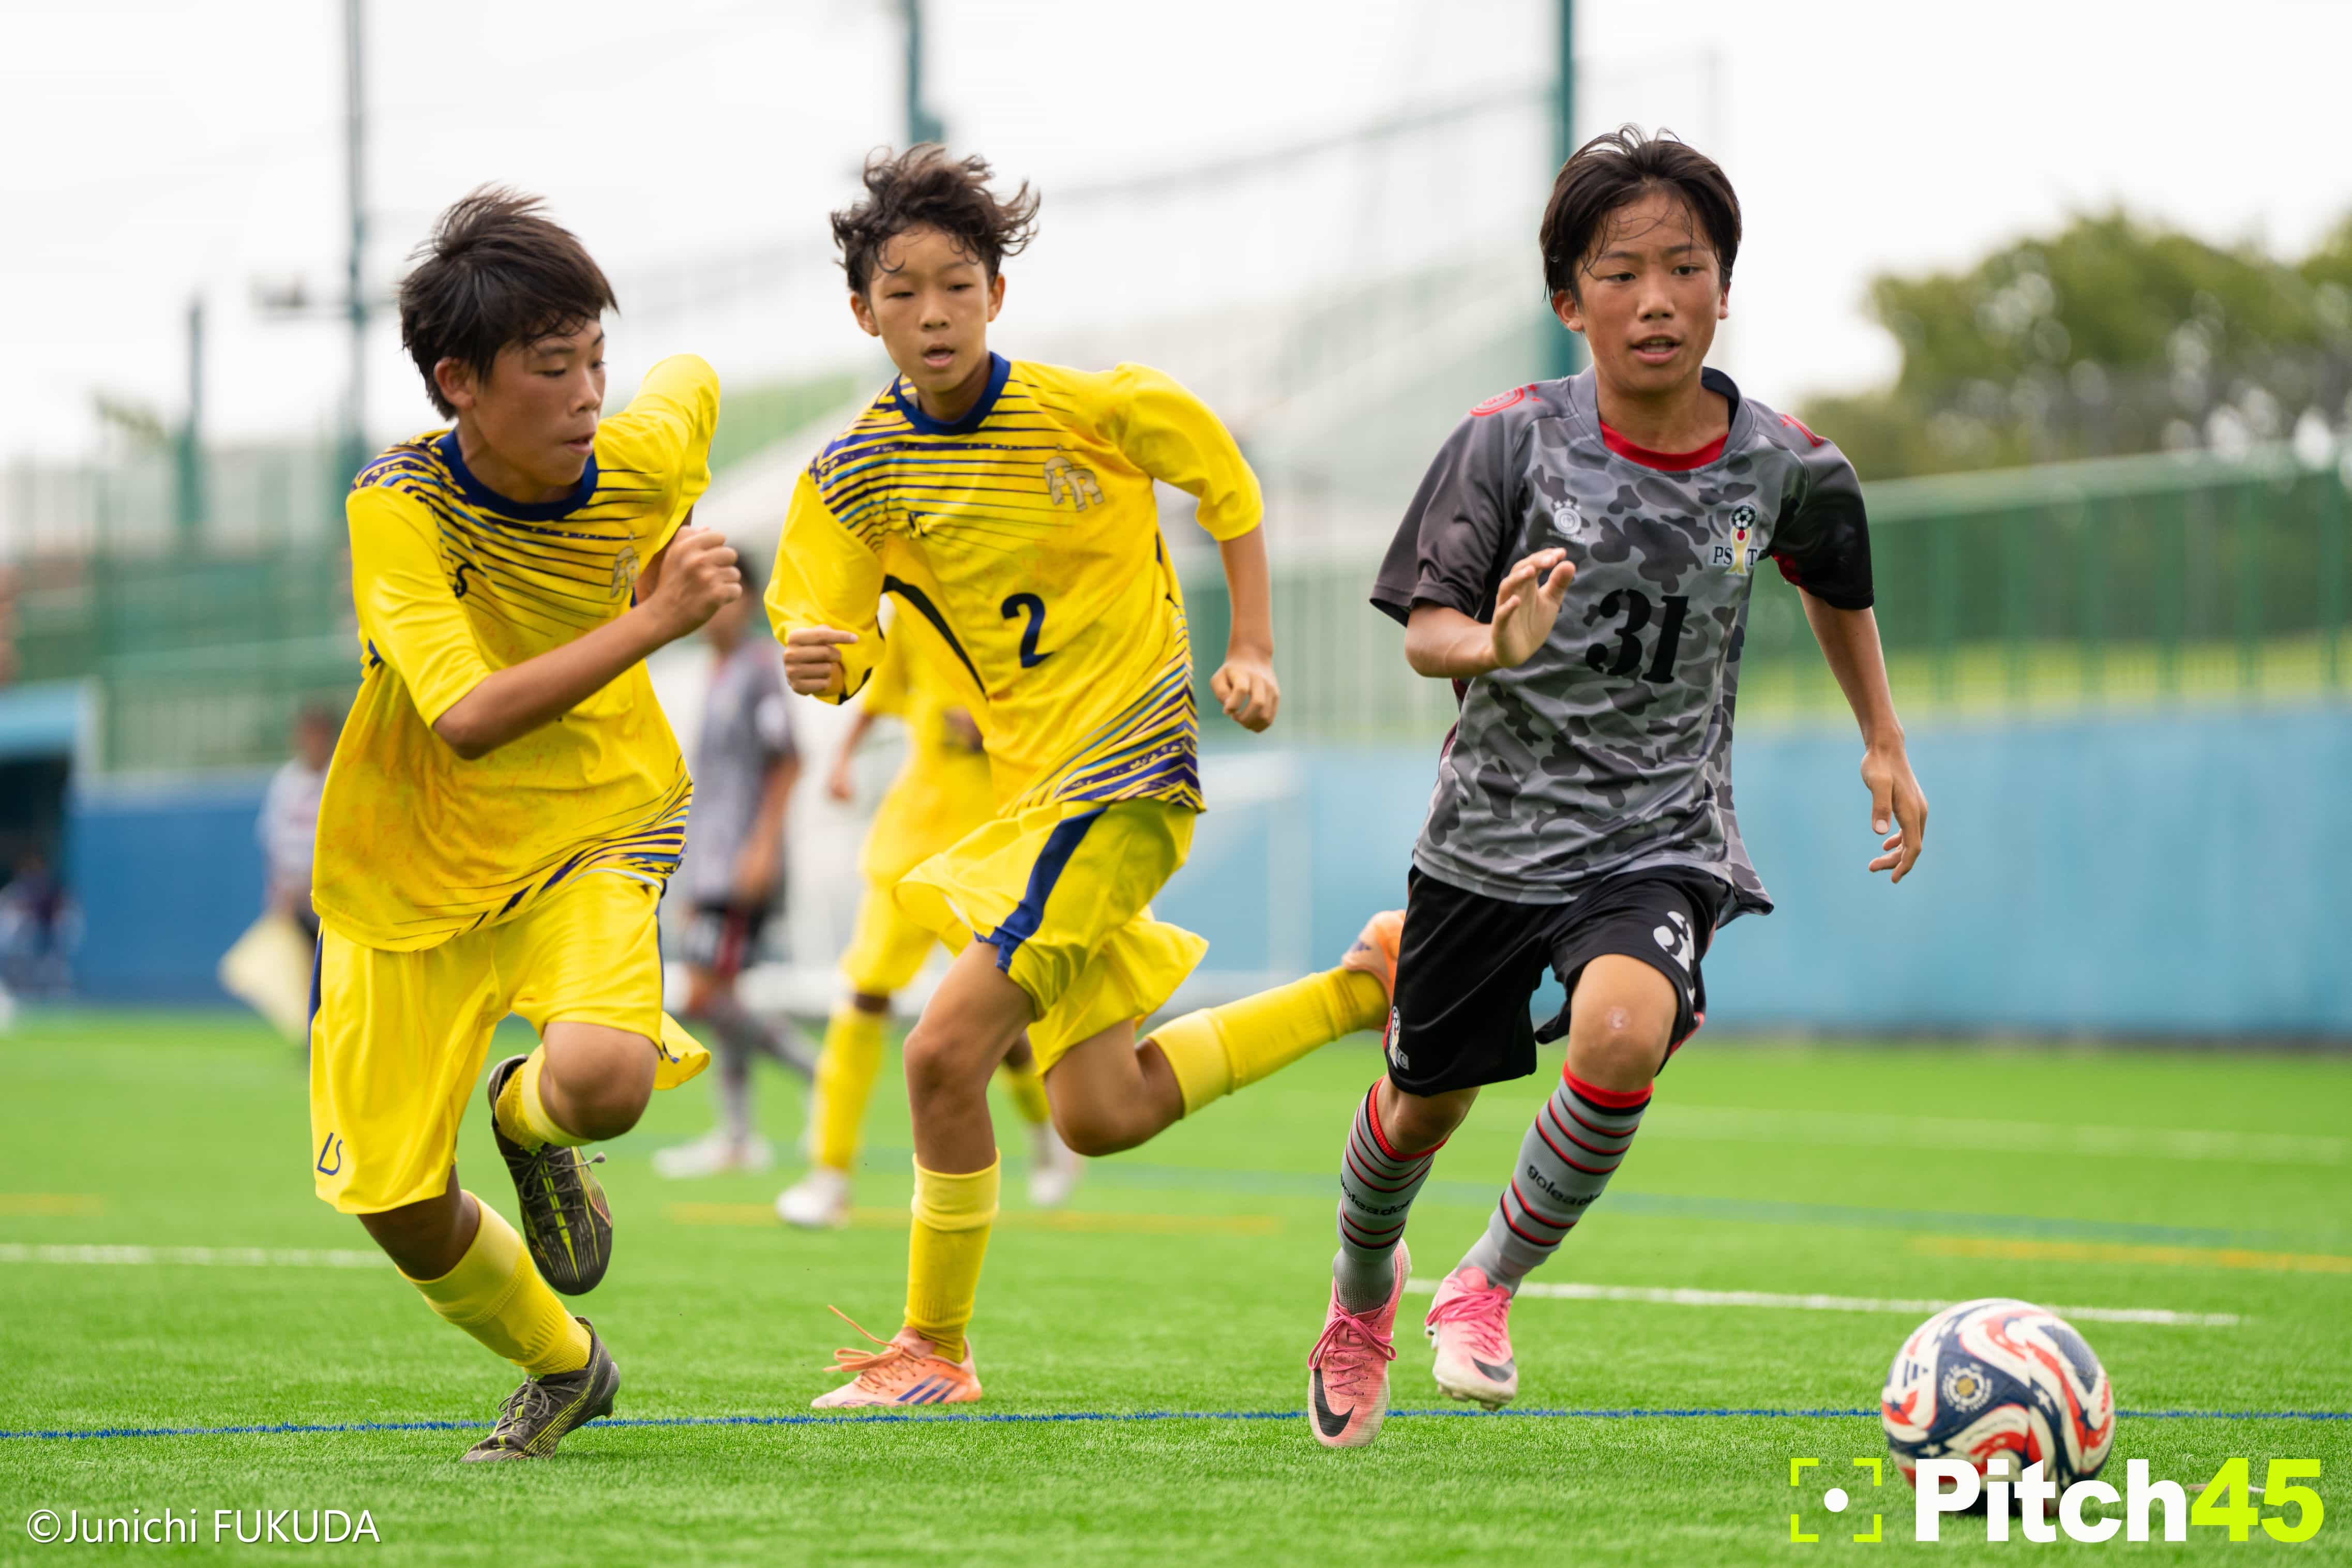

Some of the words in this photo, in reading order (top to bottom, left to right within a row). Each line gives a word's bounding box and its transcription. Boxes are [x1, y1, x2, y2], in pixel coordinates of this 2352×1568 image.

[1001, 593, 1056, 668] 2
[1586, 588, 1688, 683] 31
[1527, 1165, 1601, 1206] golead
